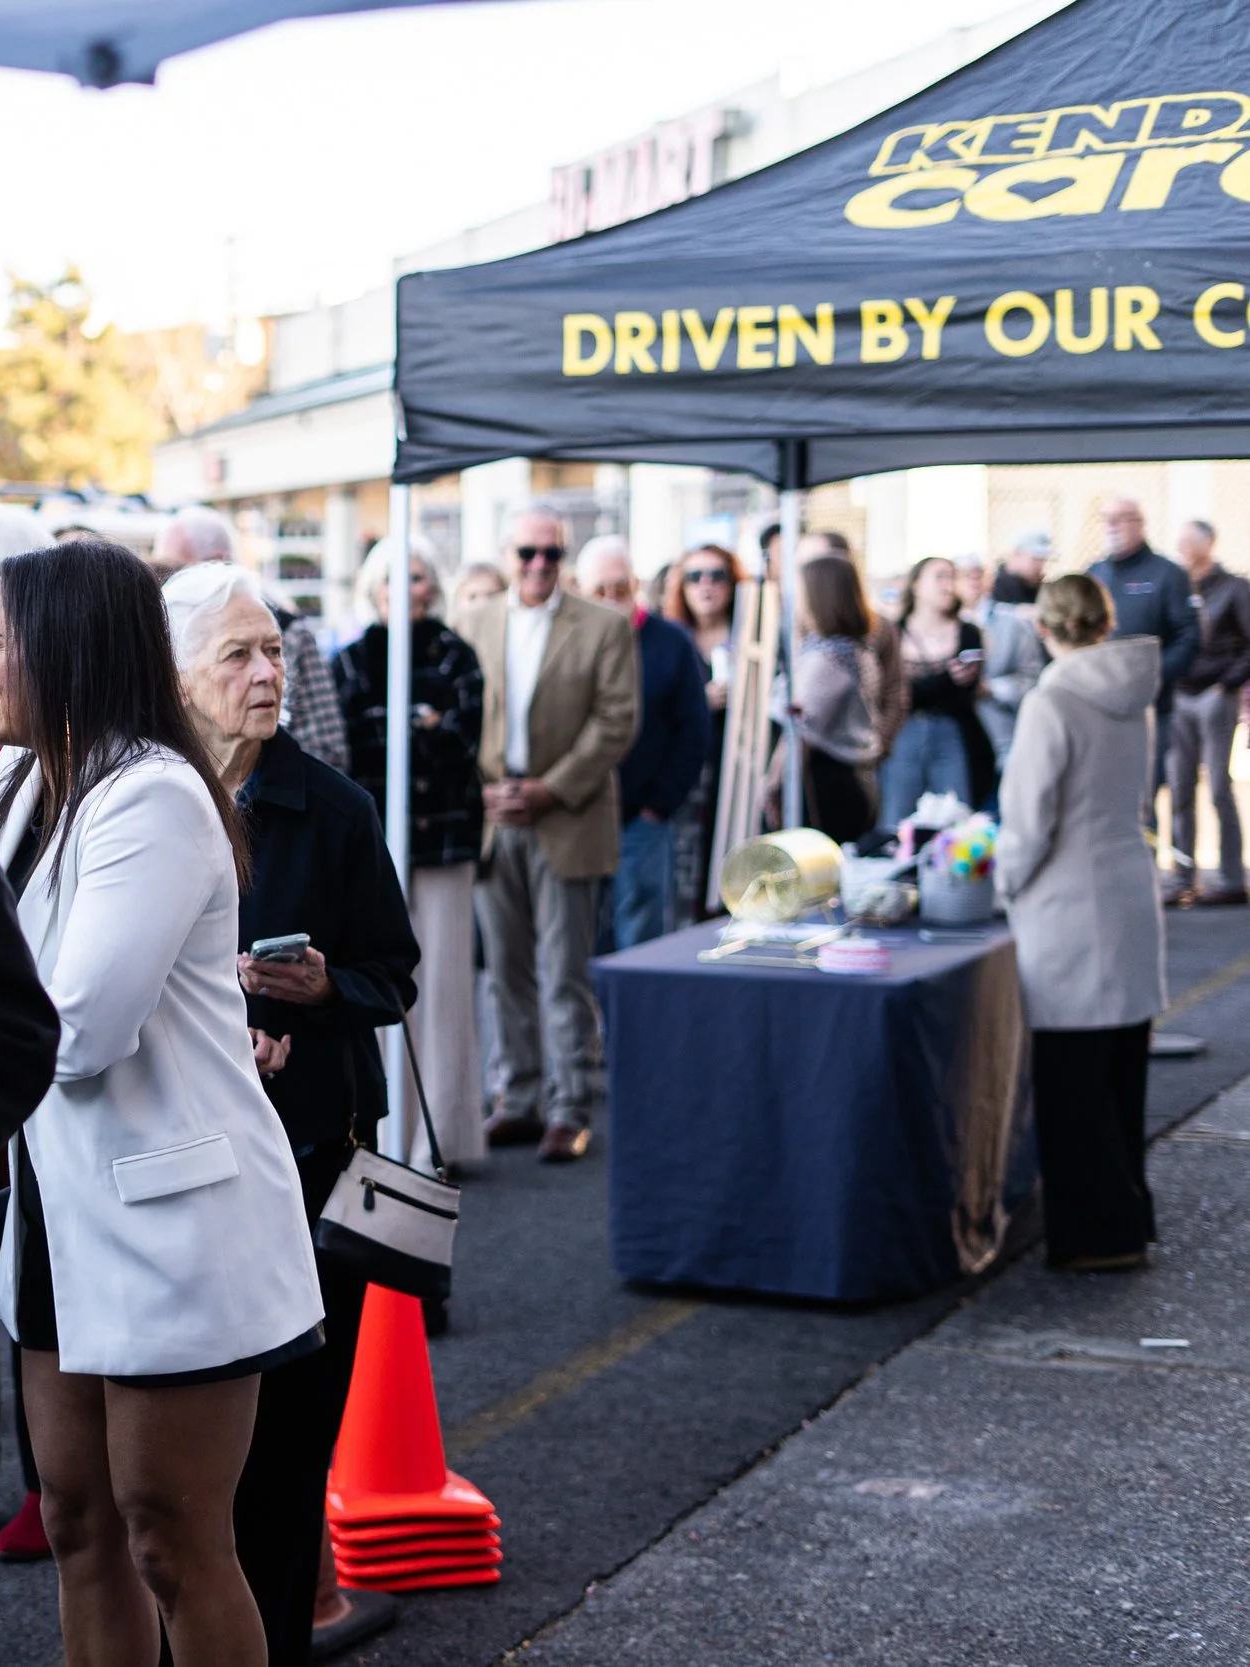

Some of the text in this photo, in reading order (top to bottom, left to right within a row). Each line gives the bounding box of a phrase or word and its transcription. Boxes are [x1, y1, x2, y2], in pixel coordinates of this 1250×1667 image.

[867, 91, 1250, 177] KEND
[562, 282, 1250, 377] DRIVEN BY OUR C
